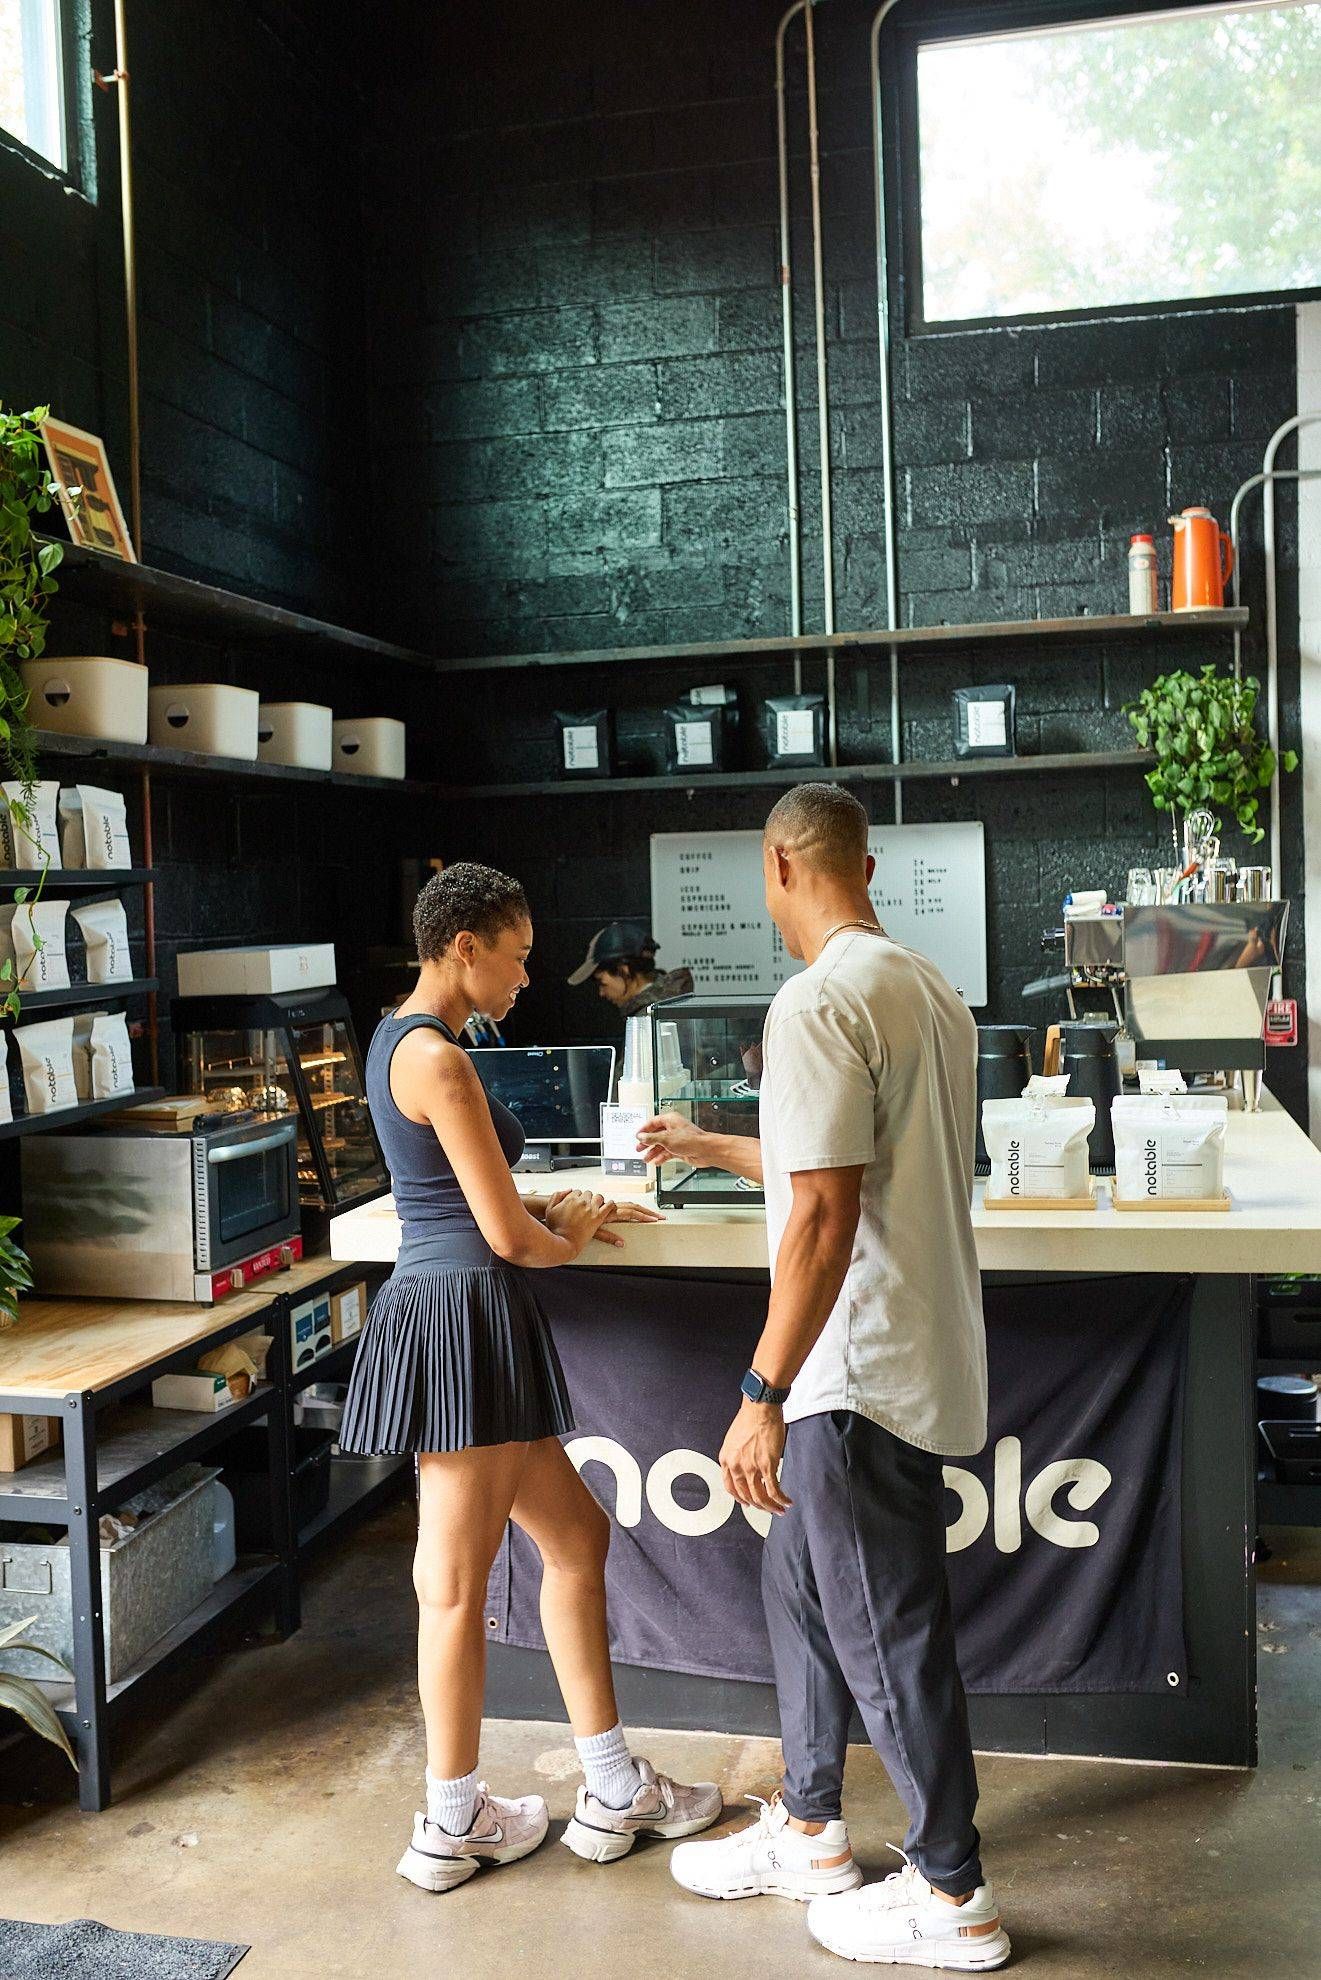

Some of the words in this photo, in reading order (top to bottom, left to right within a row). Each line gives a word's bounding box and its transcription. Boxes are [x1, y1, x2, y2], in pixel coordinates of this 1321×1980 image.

[103, 815, 113, 860] notable
[680, 866, 699, 874] DRIP
[681, 894, 725, 902] ESPRESSO
[681, 904, 731, 912] AMERICANO
[681, 922, 725, 930] ESPRESSO
[740, 922, 761, 930] MILK
[714, 973, 759, 982] ESPRESSO
[1007, 1140, 1020, 1195] notable
[1144, 1139, 1157, 1195] notable
